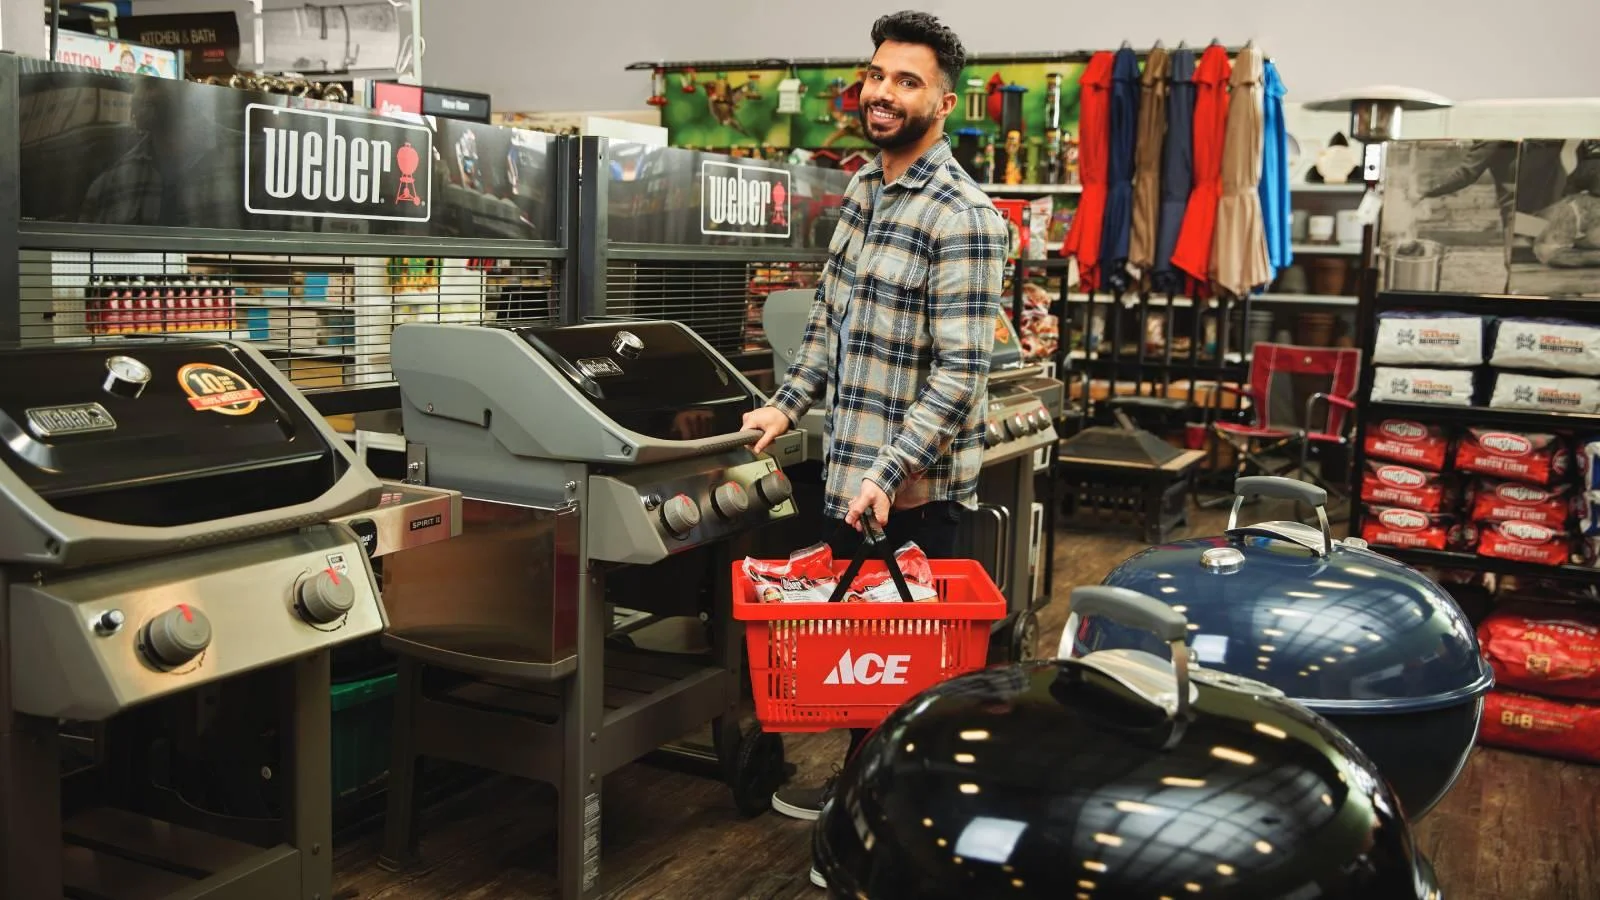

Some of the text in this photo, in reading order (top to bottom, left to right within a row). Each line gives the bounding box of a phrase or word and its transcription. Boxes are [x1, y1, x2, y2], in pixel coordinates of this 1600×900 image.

[140, 31, 181, 45] KITCHEN
[191, 29, 216, 43] BATH
[263, 117, 392, 203] weber
[709, 167, 771, 226] weber
[189, 372, 227, 394] 10
[412, 518, 434, 529] SPIRIT
[823, 648, 911, 685] ACE
